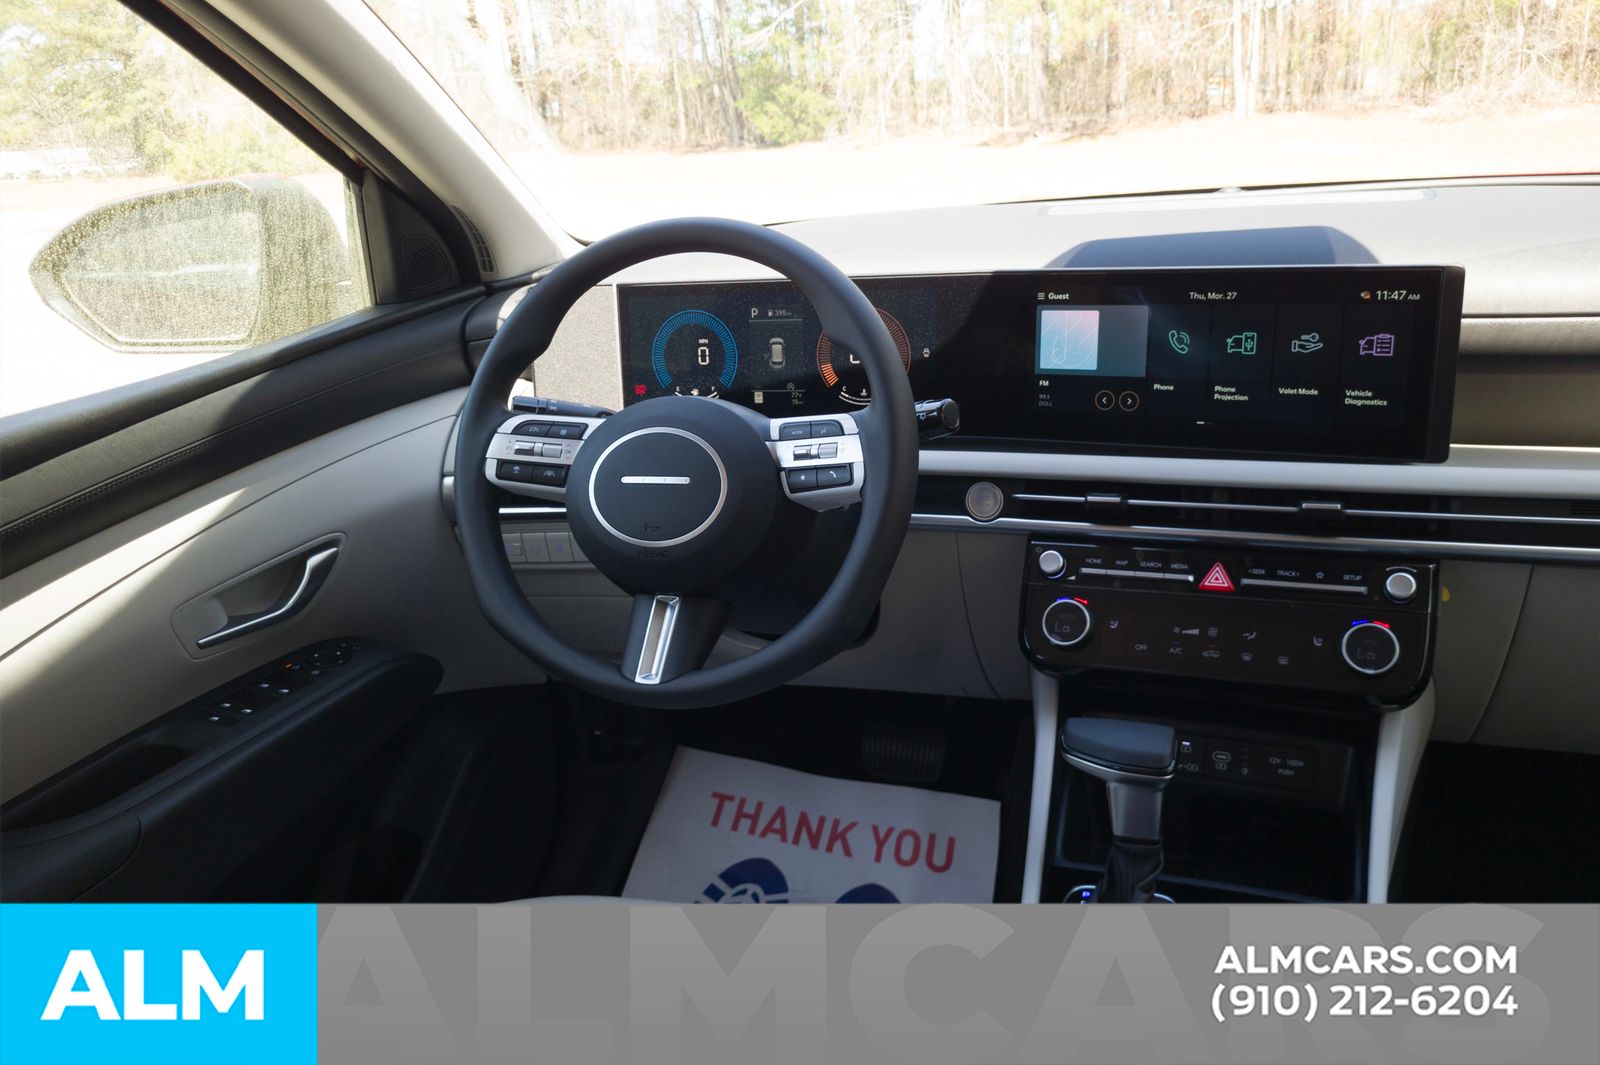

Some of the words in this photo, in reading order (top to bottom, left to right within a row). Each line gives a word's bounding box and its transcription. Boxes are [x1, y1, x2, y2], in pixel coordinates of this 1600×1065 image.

[1189, 292, 1206, 300] Thu,
[1376, 290, 1406, 300] 11:47
[752, 308, 758, 318] P
[698, 346, 709, 365] 0
[1344, 398, 1388, 406] Diagnostics
[710, 792, 860, 858] THANK
[872, 824, 956, 874] YOU
